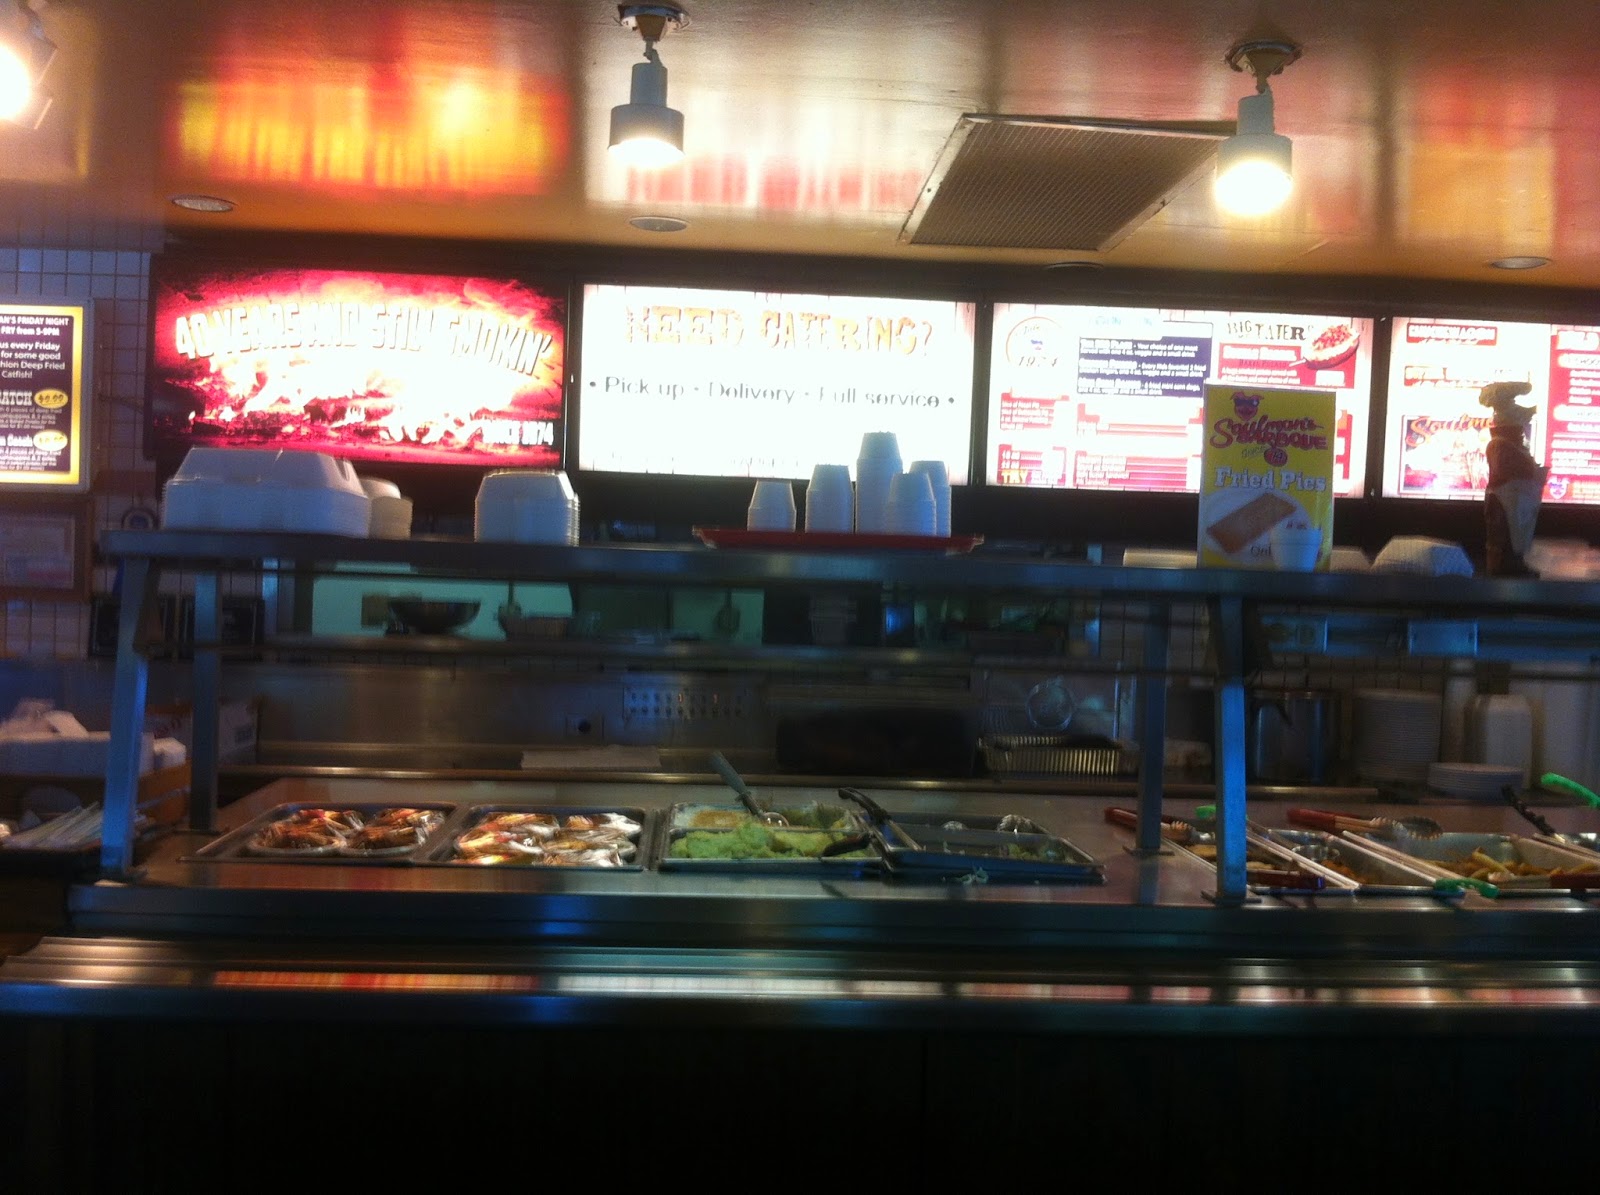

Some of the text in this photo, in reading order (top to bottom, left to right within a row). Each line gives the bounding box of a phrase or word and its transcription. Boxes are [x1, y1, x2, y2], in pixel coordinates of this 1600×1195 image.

[17, 316, 44, 325] FRIDAY
[45, 317, 69, 326] NIGHT
[1227, 319, 1252, 334] BIG
[177, 313, 215, 359] 40
[211, 303, 303, 355] YEARS
[307, 302, 361, 349] AND
[625, 304, 934, 357] NEED CATERING?
[10, 343, 33, 351] every
[35, 342, 60, 352] Friday
[1, 350, 13, 358] for
[39, 353, 60, 361] good
[20, 361, 43, 370] Deep
[44, 362, 65, 370] Fried
[1, 370, 32, 379] Catfish!
[604, 376, 940, 409] Pick up Delivery Full service
[1209, 415, 1324, 449] Soulman's
[1002, 469, 1028, 484] TRY
[1214, 467, 1327, 492] Fried Pies
